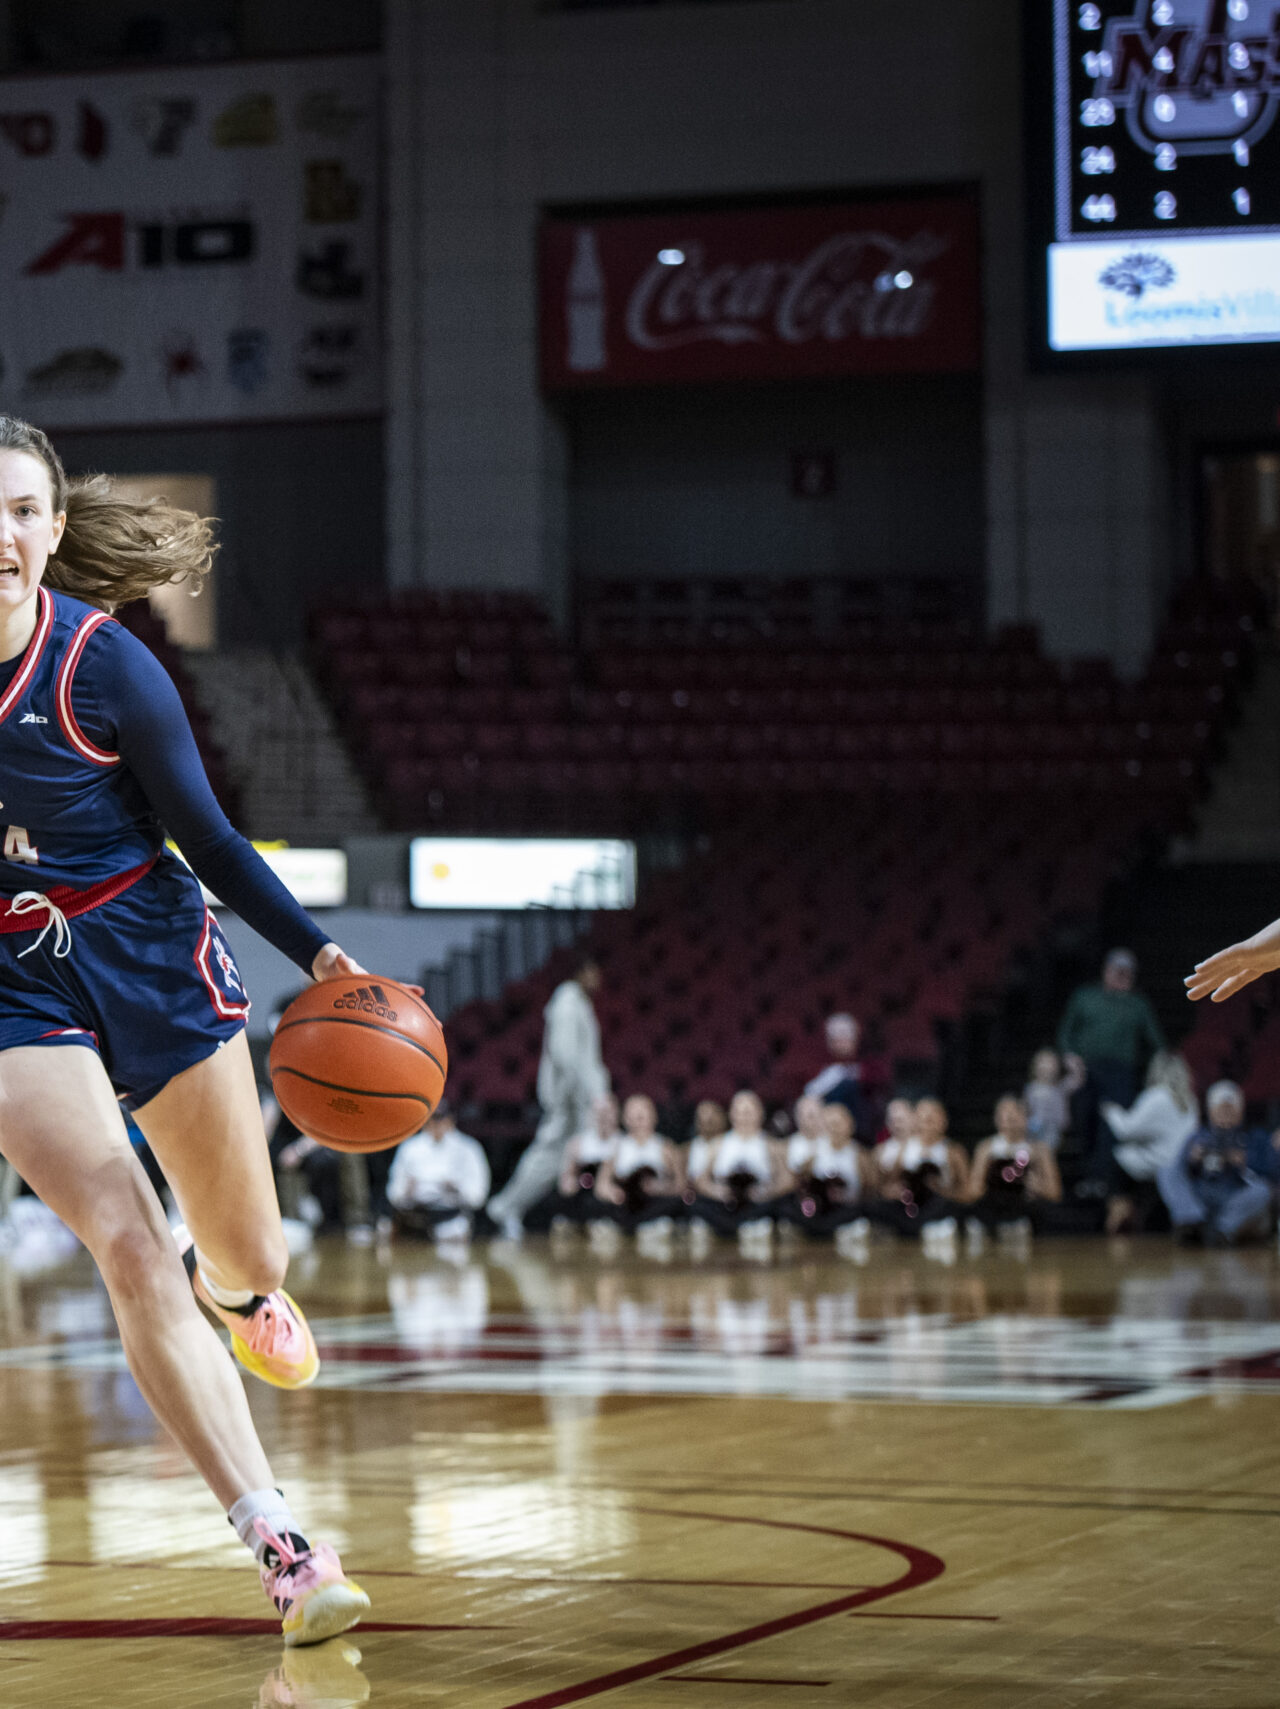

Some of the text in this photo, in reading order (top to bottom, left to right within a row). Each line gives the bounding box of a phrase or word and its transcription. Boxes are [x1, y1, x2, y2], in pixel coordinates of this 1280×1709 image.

[1154, 142, 1177, 171] 2
[1231, 139, 1249, 167] 1
[1154, 190, 1177, 220] 2
[1232, 187, 1250, 215] 1
[333, 998, 398, 1022] adidas
